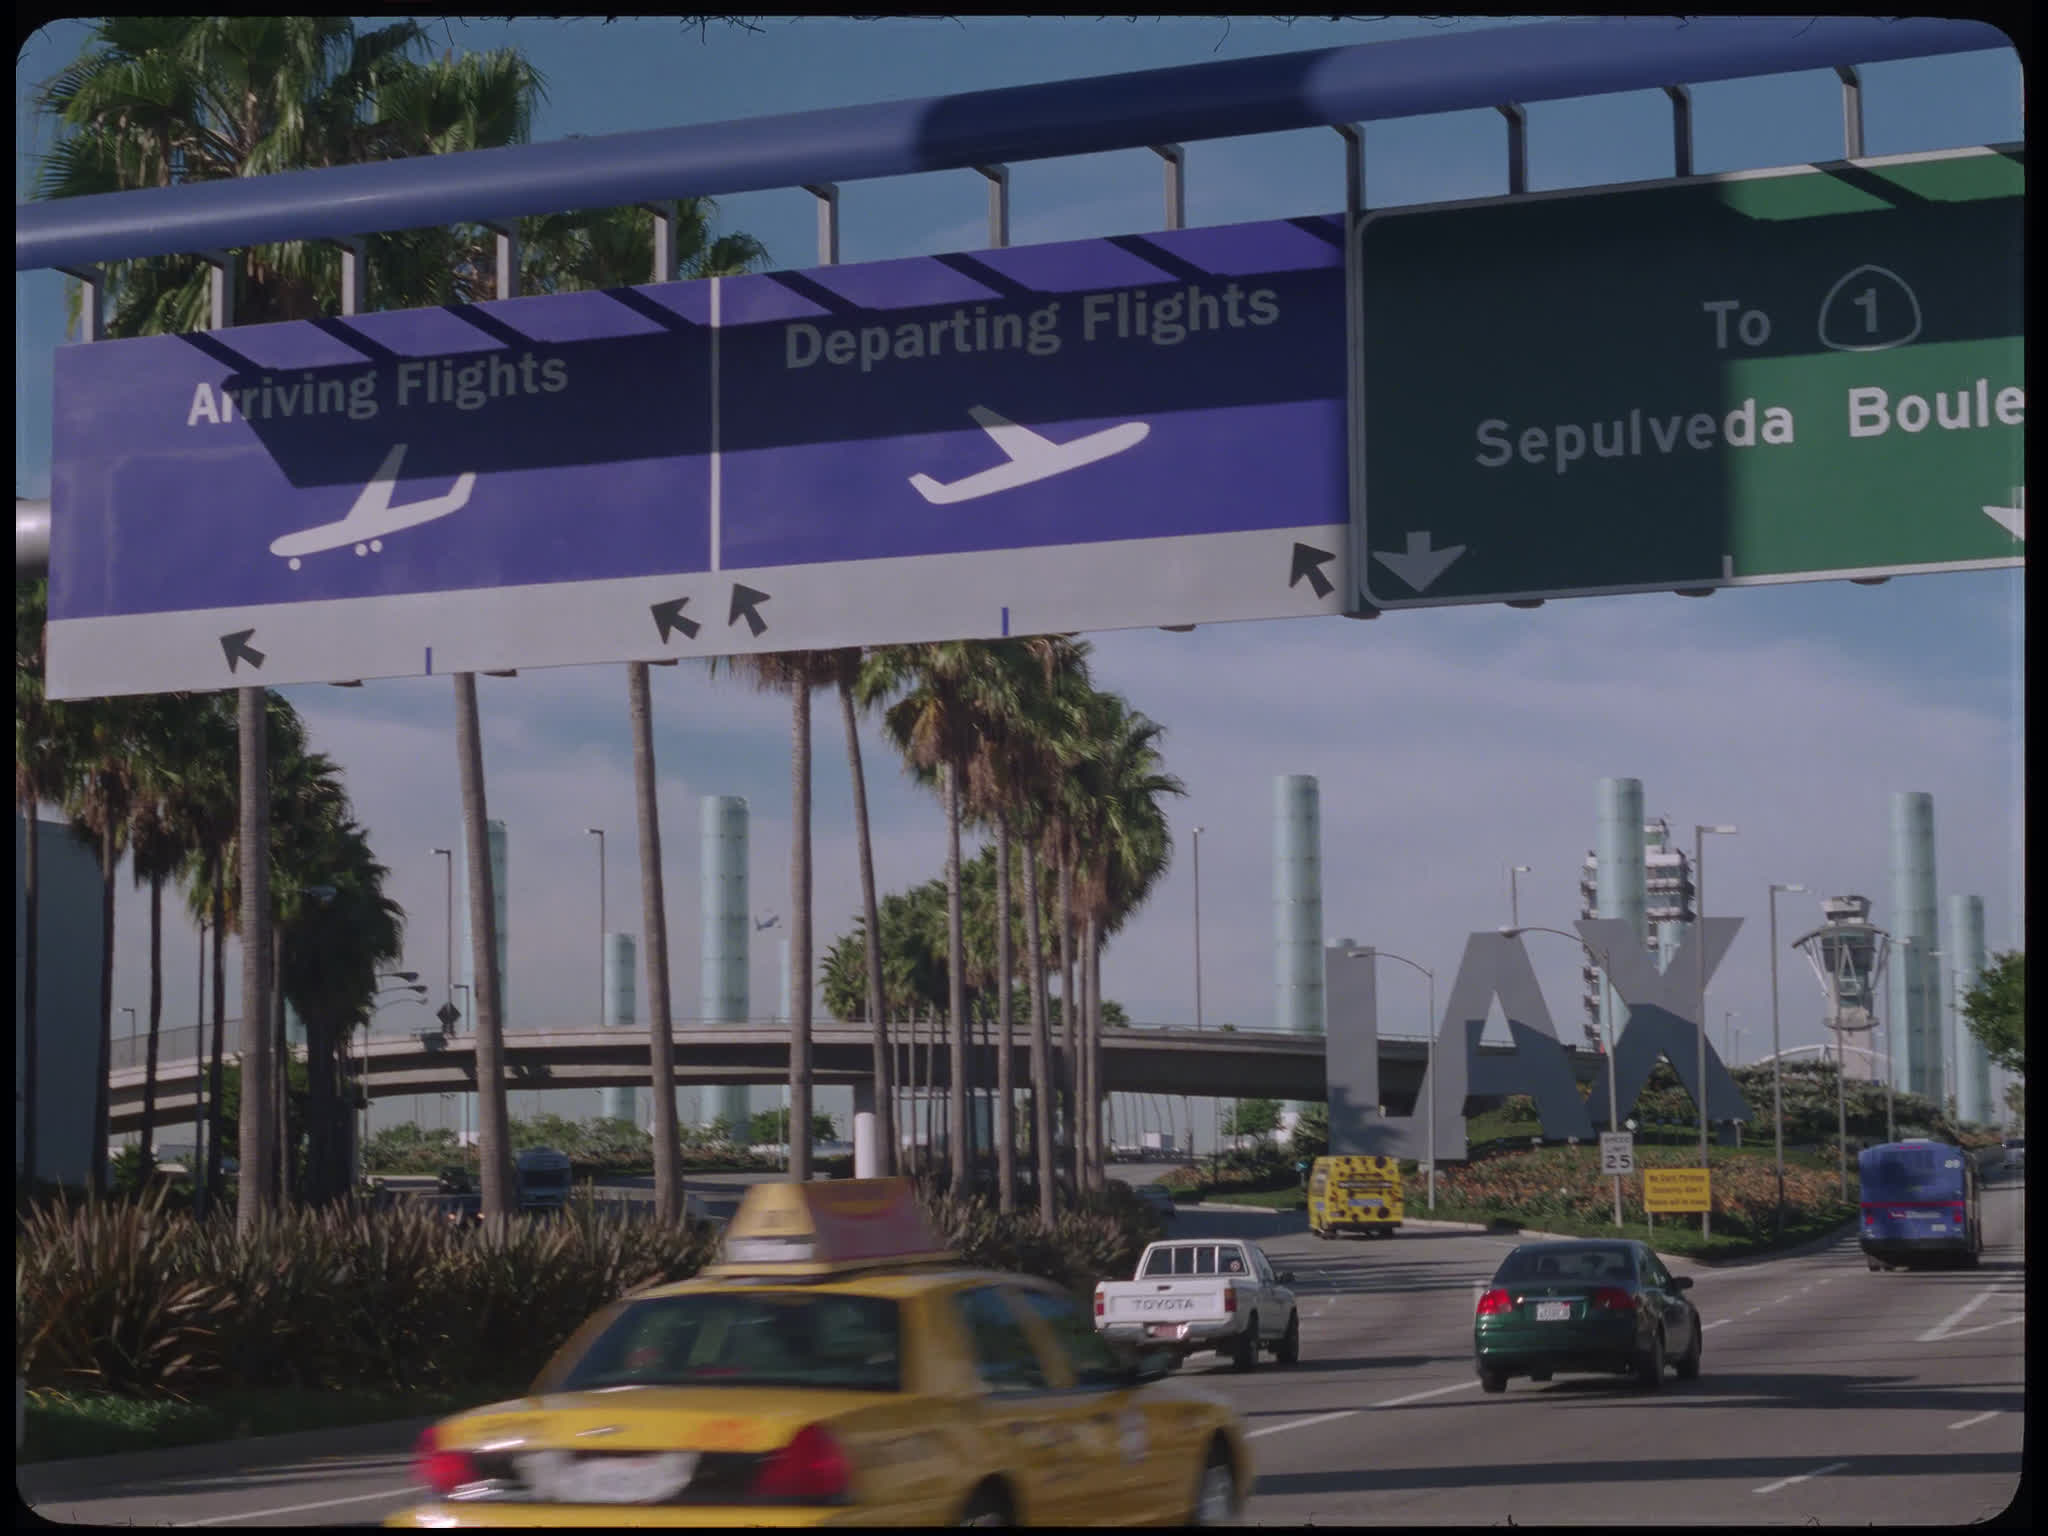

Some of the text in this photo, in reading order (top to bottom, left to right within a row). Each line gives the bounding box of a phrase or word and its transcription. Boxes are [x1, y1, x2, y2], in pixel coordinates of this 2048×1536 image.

[785, 284, 1281, 373] Departing Flights
[1703, 288, 1879, 349] To 1
[187, 351, 569, 427] Arriving Flights
[1475, 398, 1795, 475] Sepulveda
[1325, 917, 1752, 1161] LAX
[1606, 1154, 1631, 1169] 25
[1134, 1299, 1194, 1311] TOYOTA
